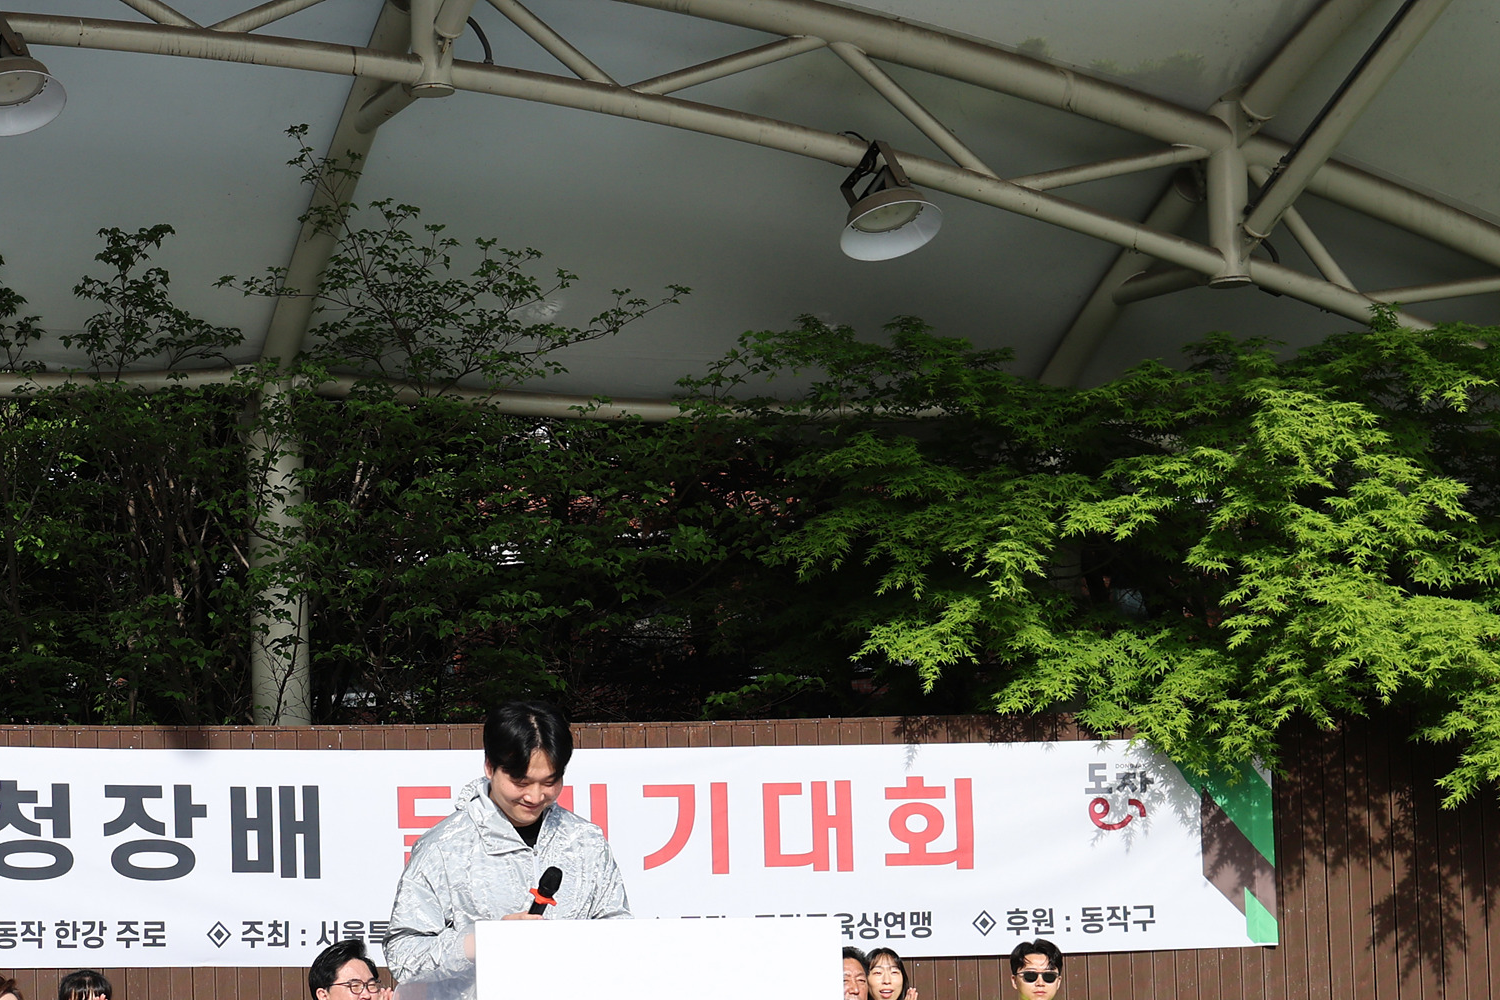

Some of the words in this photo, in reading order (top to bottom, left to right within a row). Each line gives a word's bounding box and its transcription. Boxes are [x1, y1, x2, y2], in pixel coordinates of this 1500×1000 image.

[397, 776, 975, 876] 기대회
[54, 919, 108, 949] 한강
[116, 921, 167, 949] 주로
[241, 920, 290, 949] 주최
[1006, 908, 1055, 938] 후원
[1080, 905, 1156, 934] 동작구
